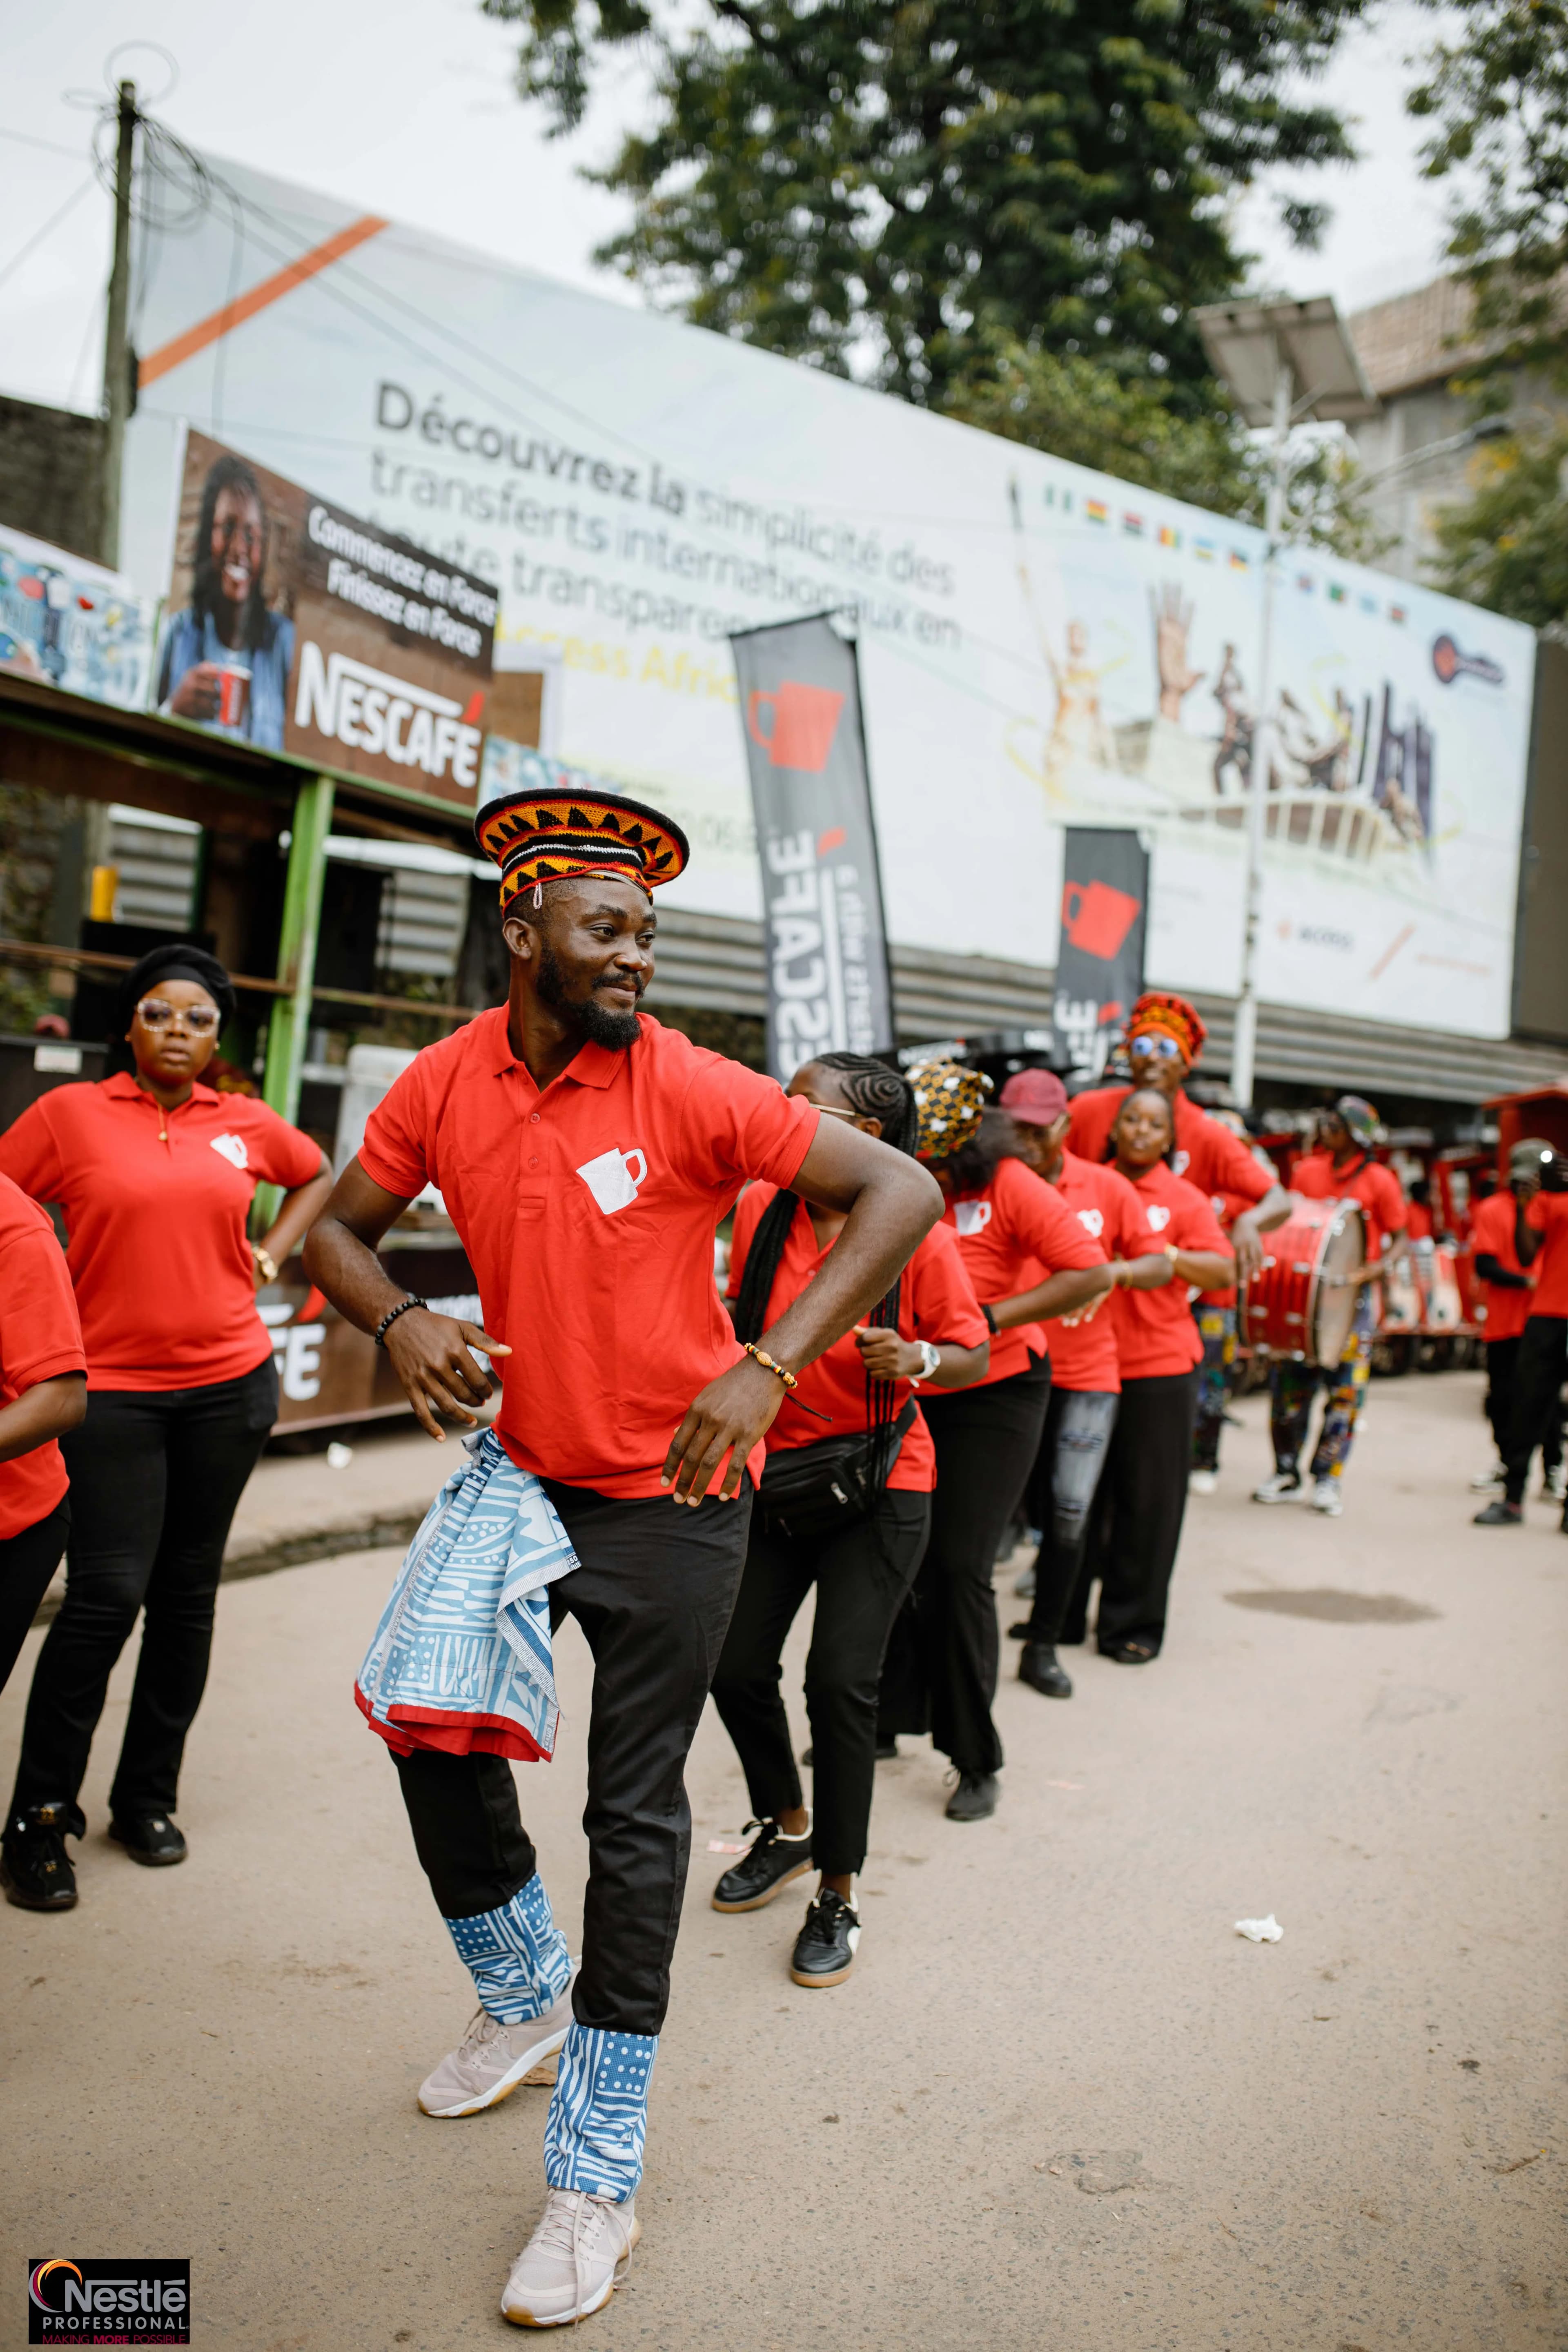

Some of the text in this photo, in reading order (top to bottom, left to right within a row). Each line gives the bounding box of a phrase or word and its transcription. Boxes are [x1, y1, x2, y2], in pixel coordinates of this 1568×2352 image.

[371, 448, 610, 554] transferts
[913, 612, 962, 652] en
[374, 381, 955, 597] Découvrez la simplicité des
[309, 506, 497, 627] Commencez en Force
[327, 558, 482, 658] Finissez en Force
[294, 641, 485, 788] NESCAFÉ
[639, 644, 740, 704] Afric
